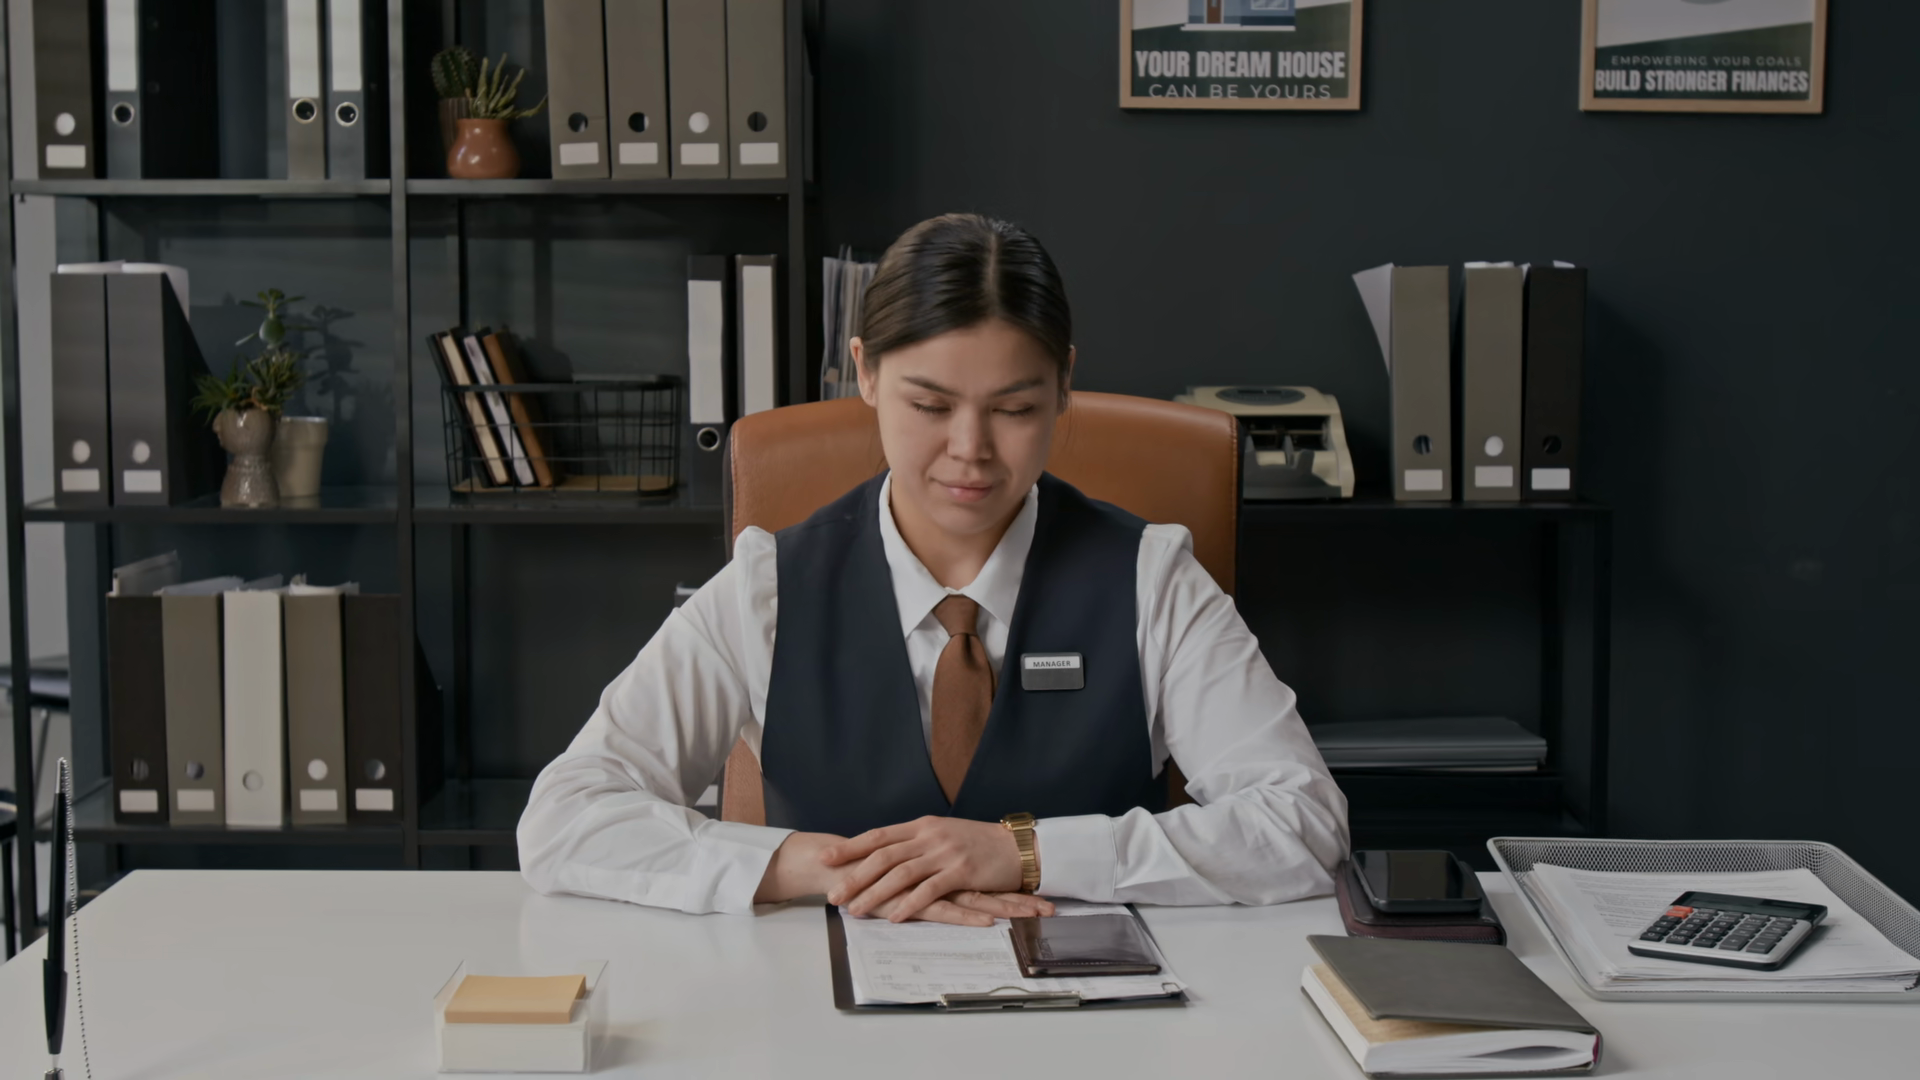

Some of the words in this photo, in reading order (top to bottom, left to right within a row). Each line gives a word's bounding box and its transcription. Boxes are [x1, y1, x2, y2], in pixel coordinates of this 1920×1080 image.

[1135, 50, 1190, 78] YOUR
[1196, 51, 1271, 78] DREAM
[1277, 51, 1346, 79] HOUSE
[1611, 55, 1708, 66] EMPOWERING
[1713, 55, 1751, 67] YOUR
[1756, 56, 1802, 67] GOALS
[1595, 69, 1641, 91] BUILD
[1645, 69, 1728, 92] STRONGER
[1731, 70, 1809, 93] FINANCES
[1148, 83, 1197, 98] CAN
[1210, 84, 1239, 99] BE
[1250, 84, 1331, 99] YOURS
[1033, 660, 1071, 668] MANAGER
